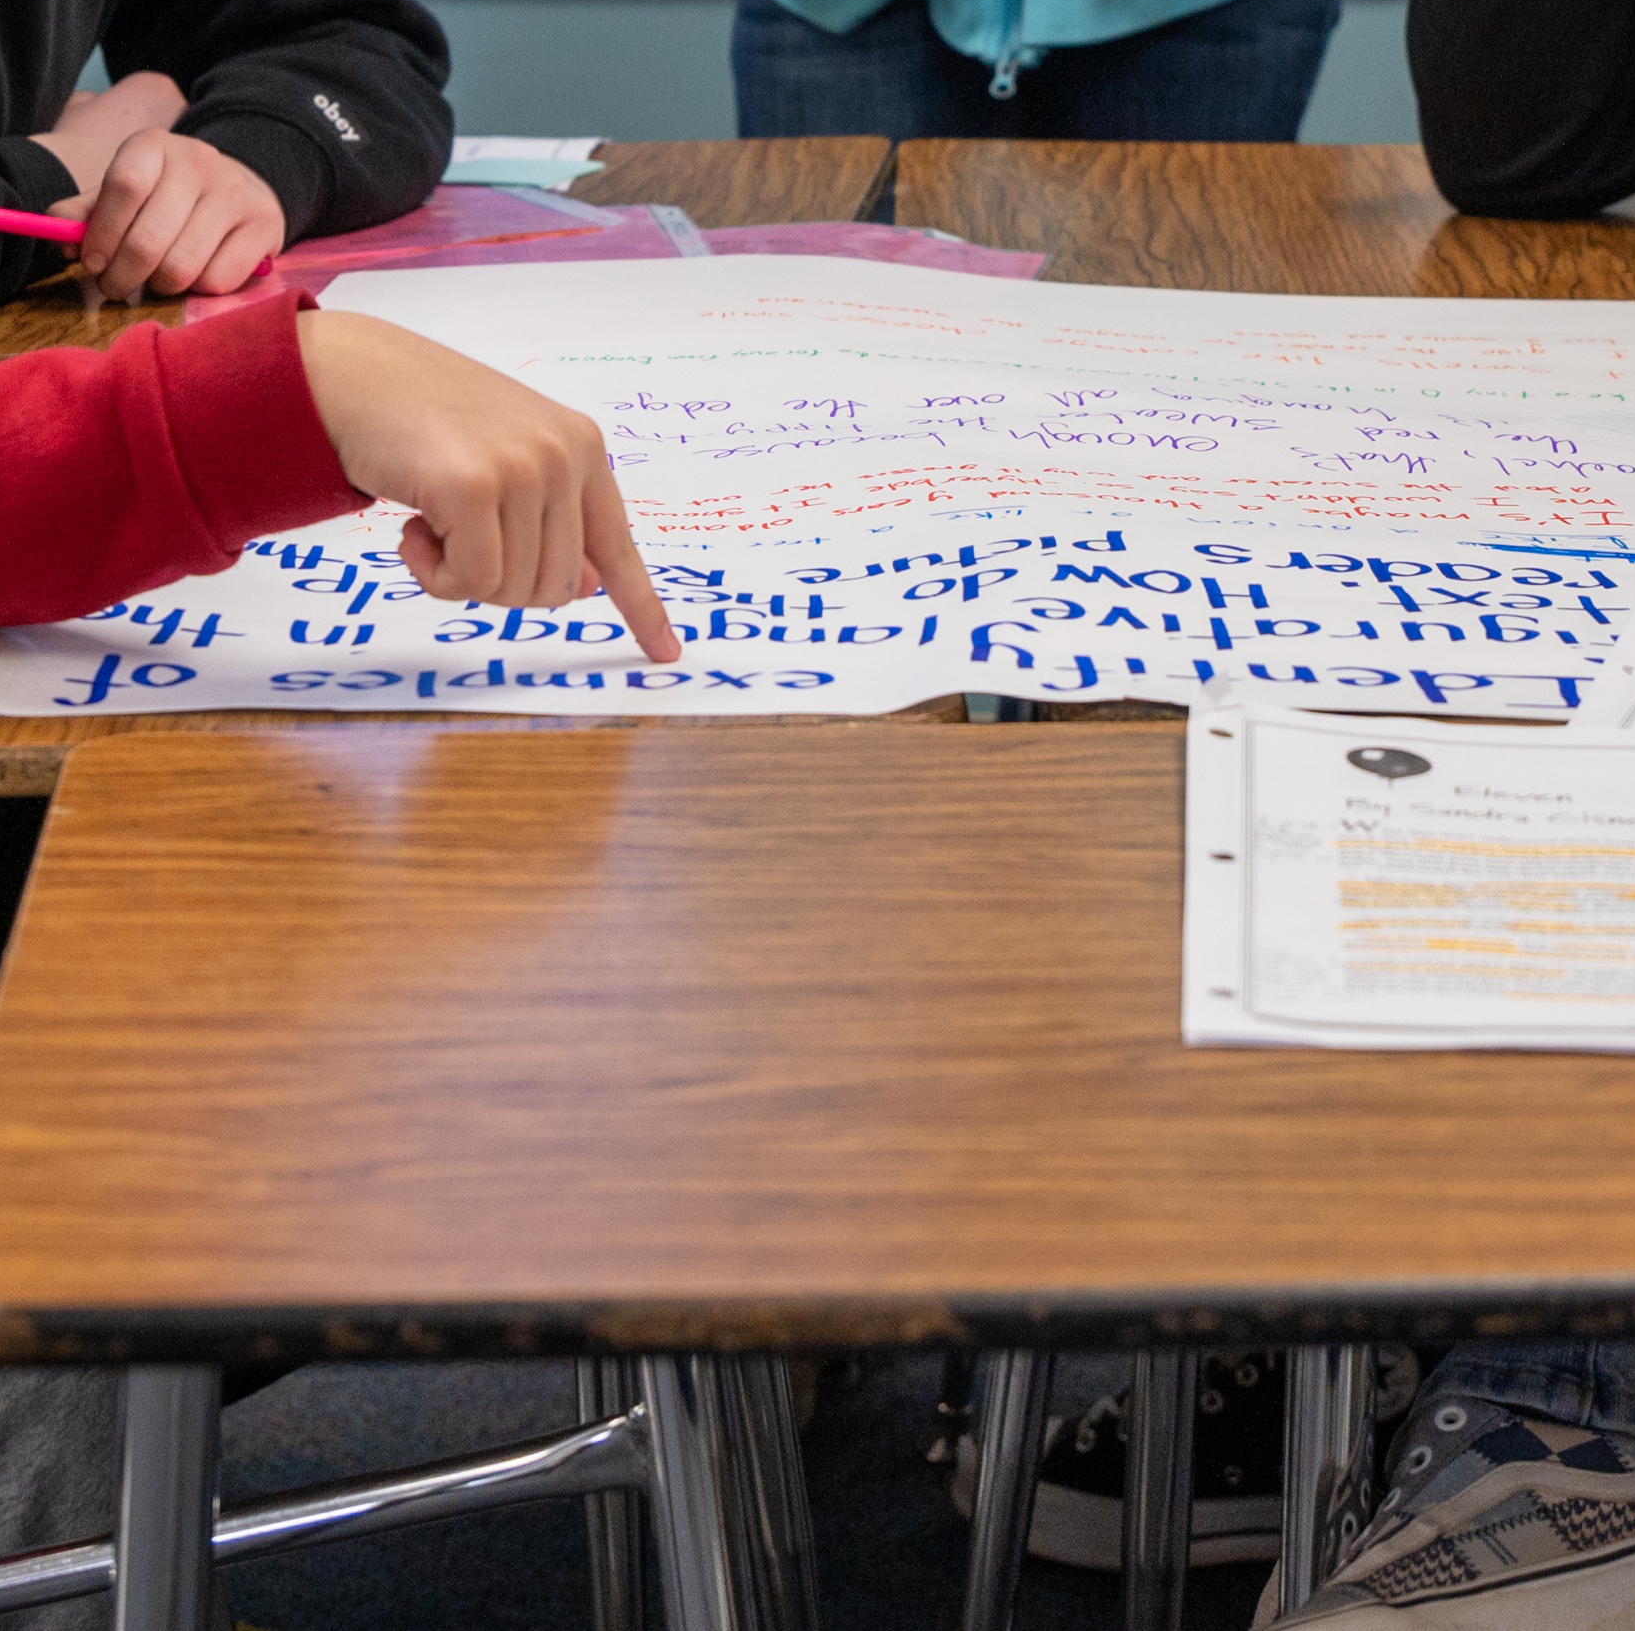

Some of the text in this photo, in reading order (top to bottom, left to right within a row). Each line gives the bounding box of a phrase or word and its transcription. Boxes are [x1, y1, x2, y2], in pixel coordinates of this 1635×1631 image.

[313, 94, 360, 141] obey
[602, 391, 732, 420] edge
[780, 398, 869, 419] the
[904, 393, 1006, 409] over
[1041, 389, 1119, 408] all
[1032, 408, 1285, 432] sweater
[691, 431, 947, 460] because
[1354, 426, 1441, 442] red
[1134, 474, 1202, 483] and
[1167, 485, 1238, 498] say
[1394, 482, 1464, 492] the
[832, 489, 955, 518] years
[986, 490, 1204, 512] thousand
[1236, 504, 1265, 512] a
[1300, 505, 1472, 521] maybe
[1496, 511, 1635, 528] It's
[783, 530, 1126, 585] picture
[1194, 543, 1618, 590] readers
[292, 563, 483, 616] elp
[902, 568, 1019, 603] do
[1050, 564, 1269, 610] How
[1341, 580, 1630, 625] text.
[289, 619, 377, 656] in
[434, 607, 938, 646] language
[54, 621, 1595, 709] Identify examples of
[1453, 784, 1573, 805] Eleven
